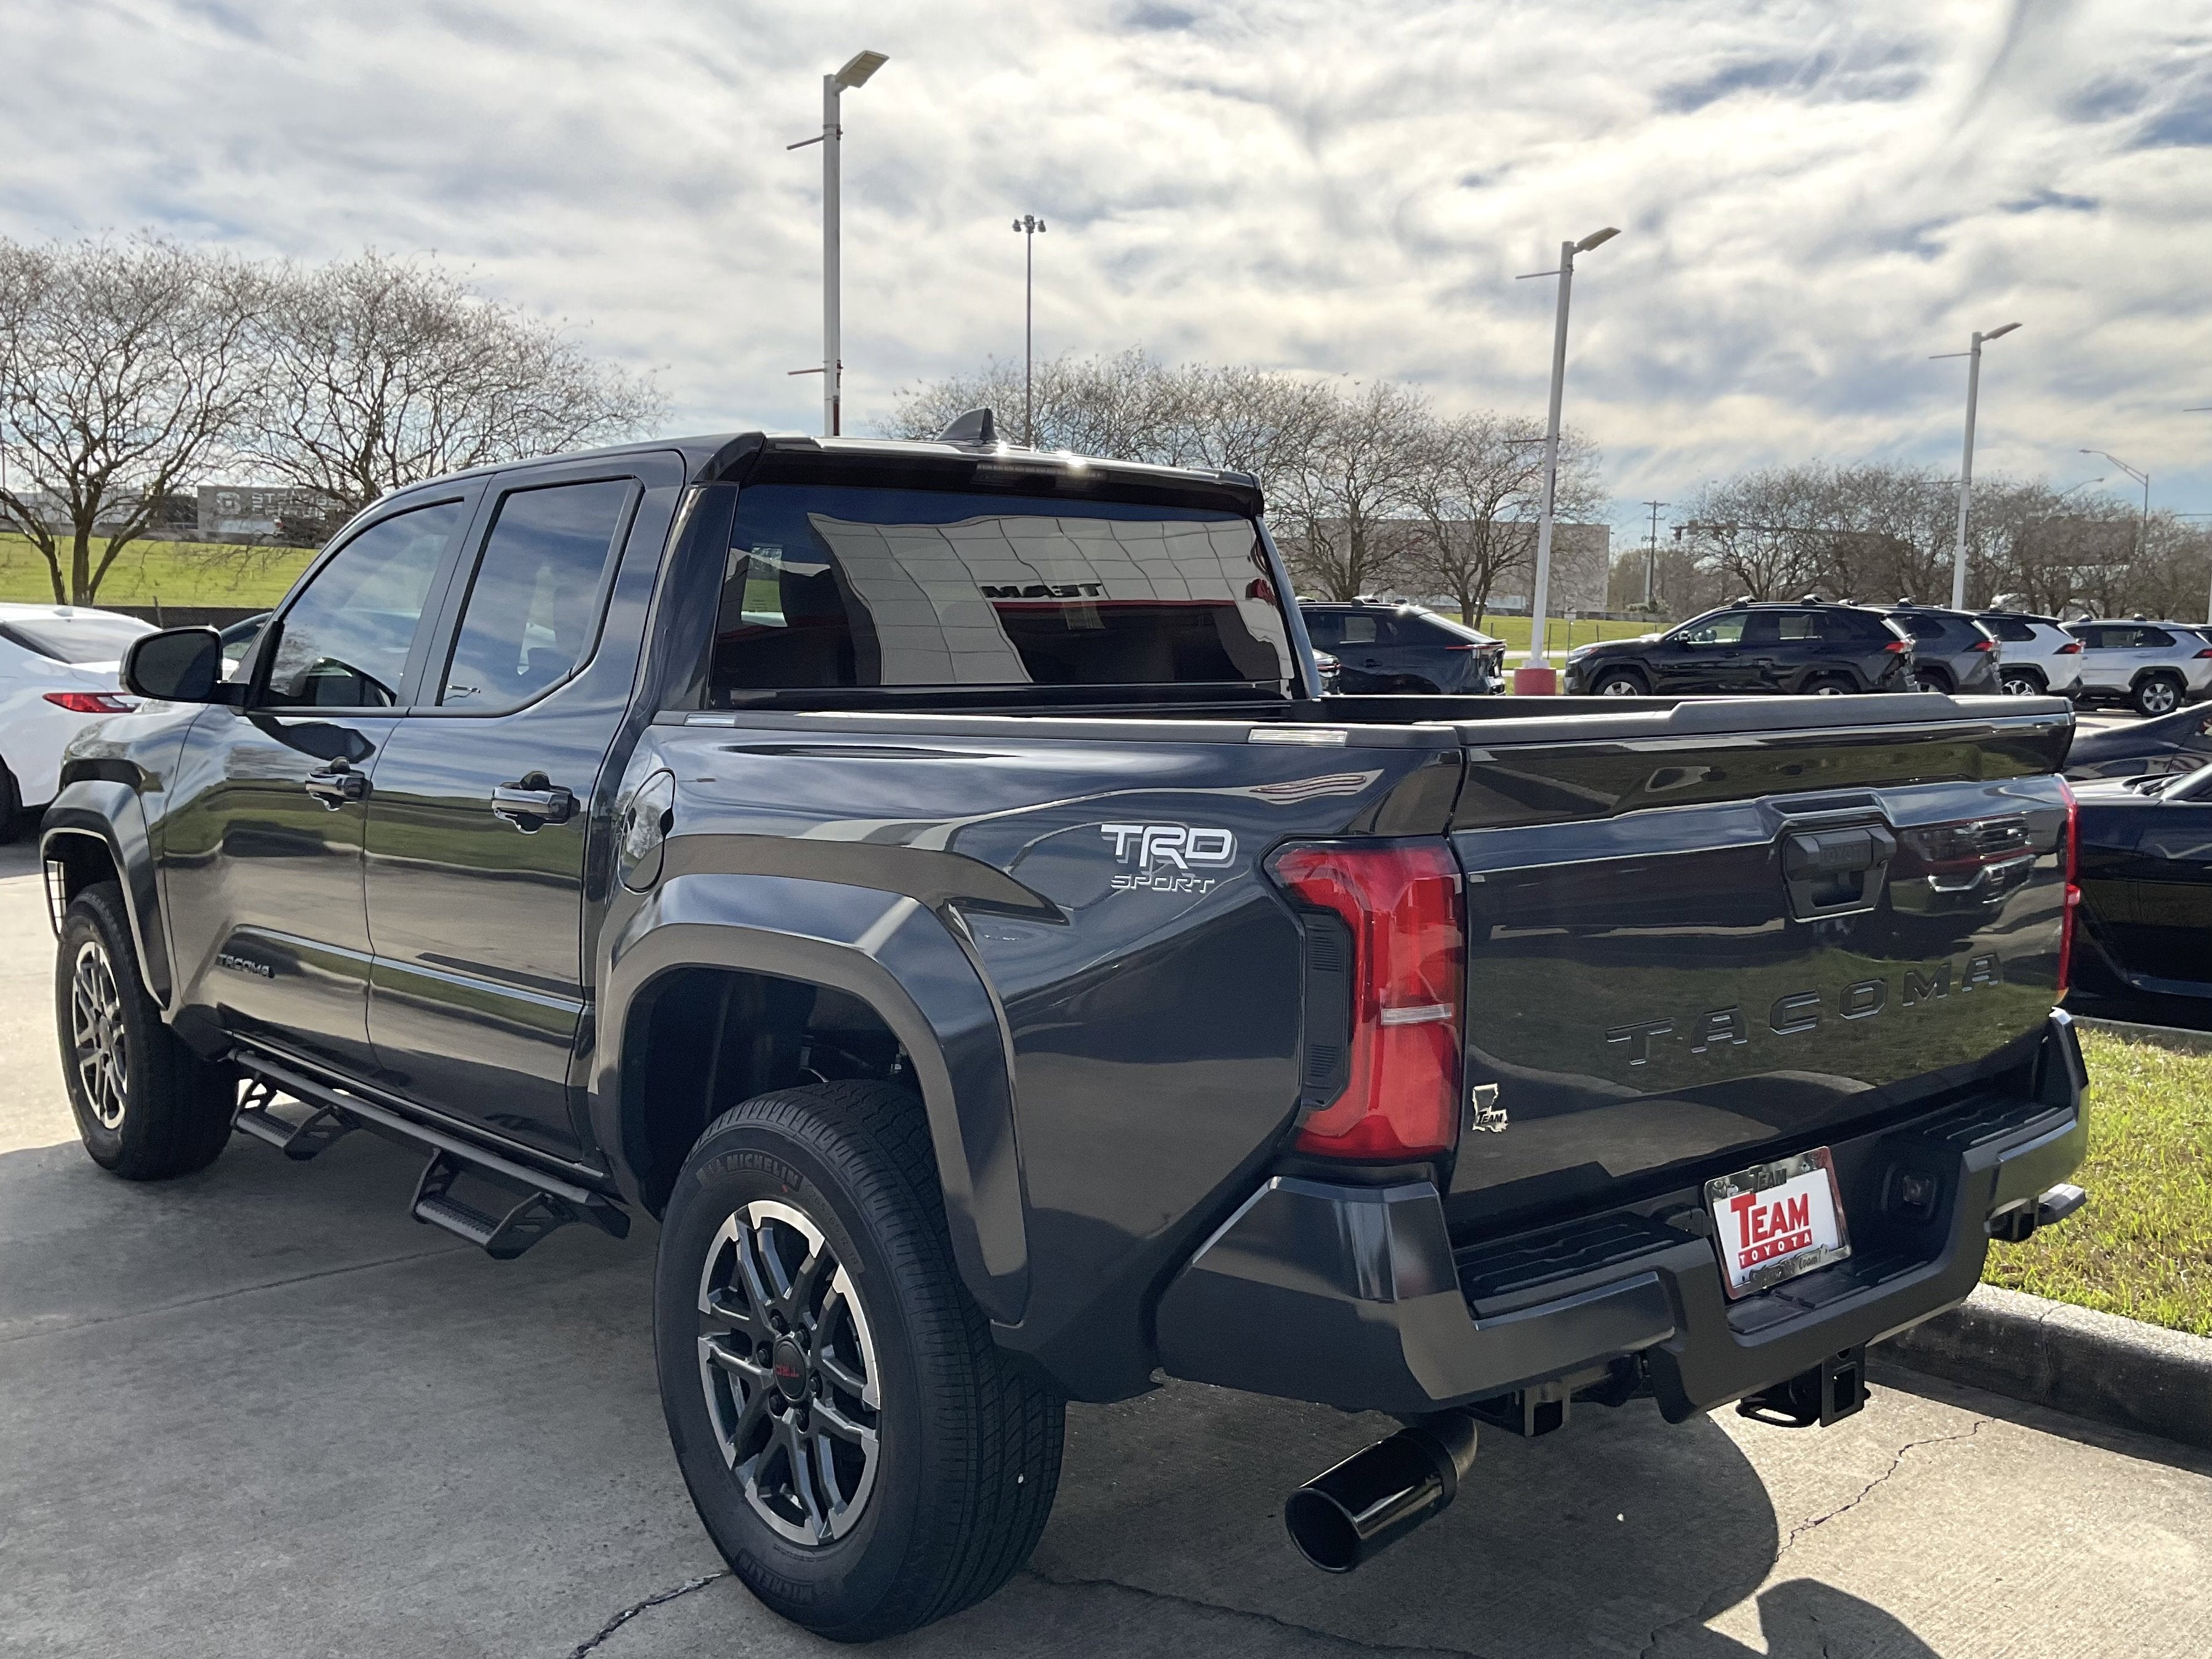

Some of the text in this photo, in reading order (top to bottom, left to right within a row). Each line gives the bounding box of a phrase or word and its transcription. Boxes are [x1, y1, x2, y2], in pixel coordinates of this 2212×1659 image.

[1100, 824, 1236, 869] TRD
[1110, 874, 1215, 893] SPORT
[215, 953, 274, 978] TACOMA
[1605, 953, 2000, 1066] TACOMA
[1478, 1109, 1504, 1124] TEAM
[726, 1153, 799, 1187] MICHELIN
[1730, 1193, 1809, 1249] TEAM
[1739, 1233, 1811, 1266] TOYOTA
